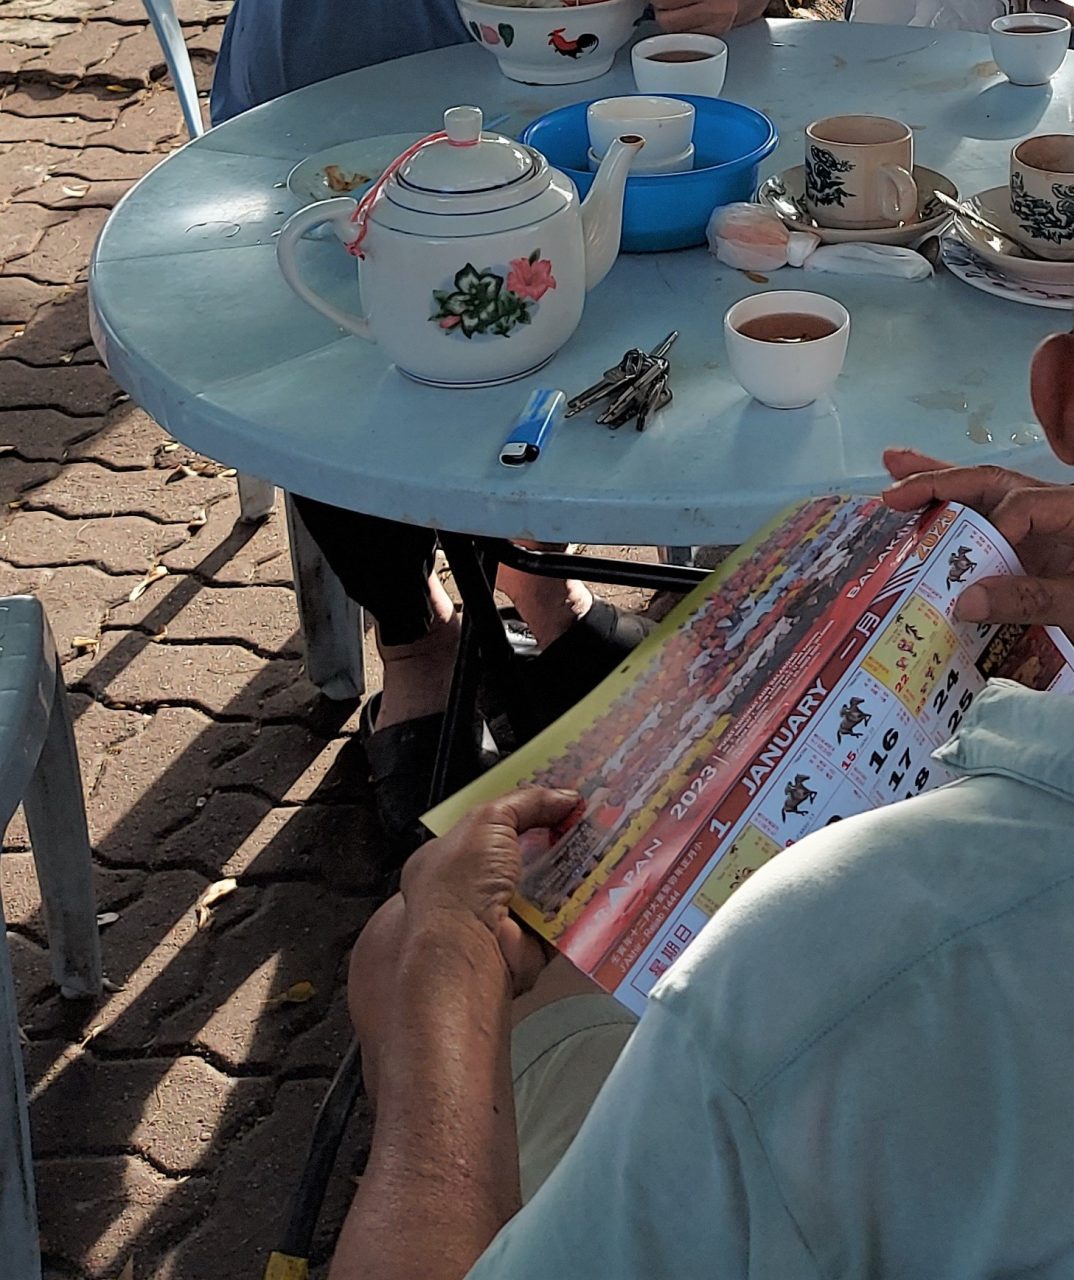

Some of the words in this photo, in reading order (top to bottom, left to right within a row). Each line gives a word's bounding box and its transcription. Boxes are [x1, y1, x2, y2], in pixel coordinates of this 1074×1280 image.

[915, 508, 958, 561] 2023
[840, 612, 881, 660] 一月
[841, 750, 857, 771] 15
[895, 674, 910, 694] 22
[888, 746, 911, 792] 17
[933, 669, 959, 714] 24
[947, 689, 974, 734] 25
[709, 816, 732, 839] 1
[742, 678, 831, 796] JANUARY
[869, 727, 899, 774] 16
[670, 764, 718, 820] 2023
[649, 923, 693, 978] 星期日
